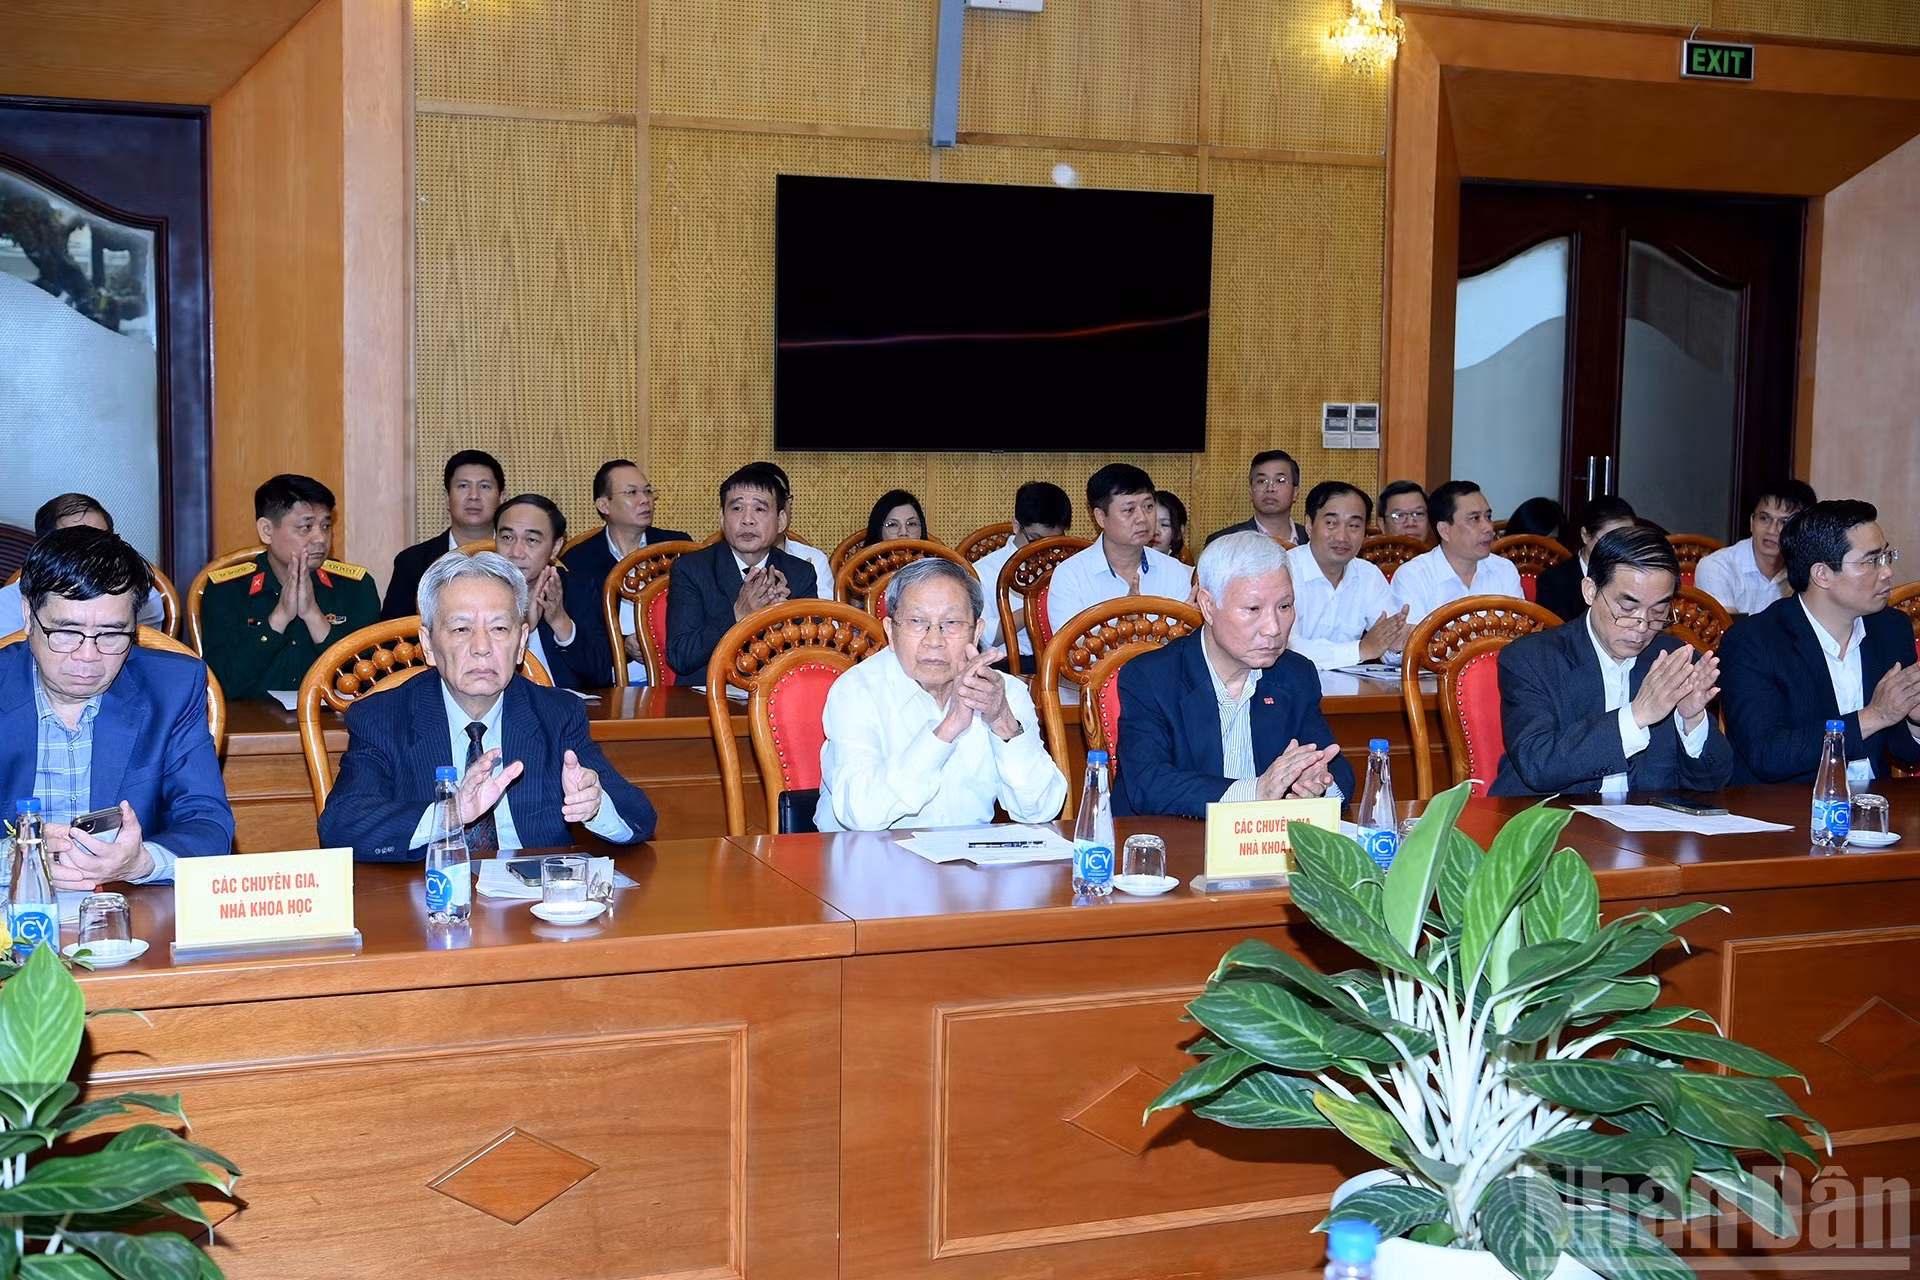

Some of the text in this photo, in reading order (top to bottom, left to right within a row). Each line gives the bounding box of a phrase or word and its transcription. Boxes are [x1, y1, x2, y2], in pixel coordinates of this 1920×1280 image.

[1692, 47, 1745, 75] EXIT
[1234, 818, 1253, 834] CÁC
[1256, 816, 1289, 833] CHUYÊ
[1239, 840, 1259, 856] NHÀ
[1261, 841, 1287, 855] KHOA
[1372, 838, 1396, 854] ICY
[1085, 852, 1111, 870] ICY
[212, 871, 320, 894] CÁC CHUYÊN GIA,
[426, 877, 448, 895] CY
[219, 897, 313, 919] NHÀ KHOA HỌC
[16, 918, 49, 939] ICY
